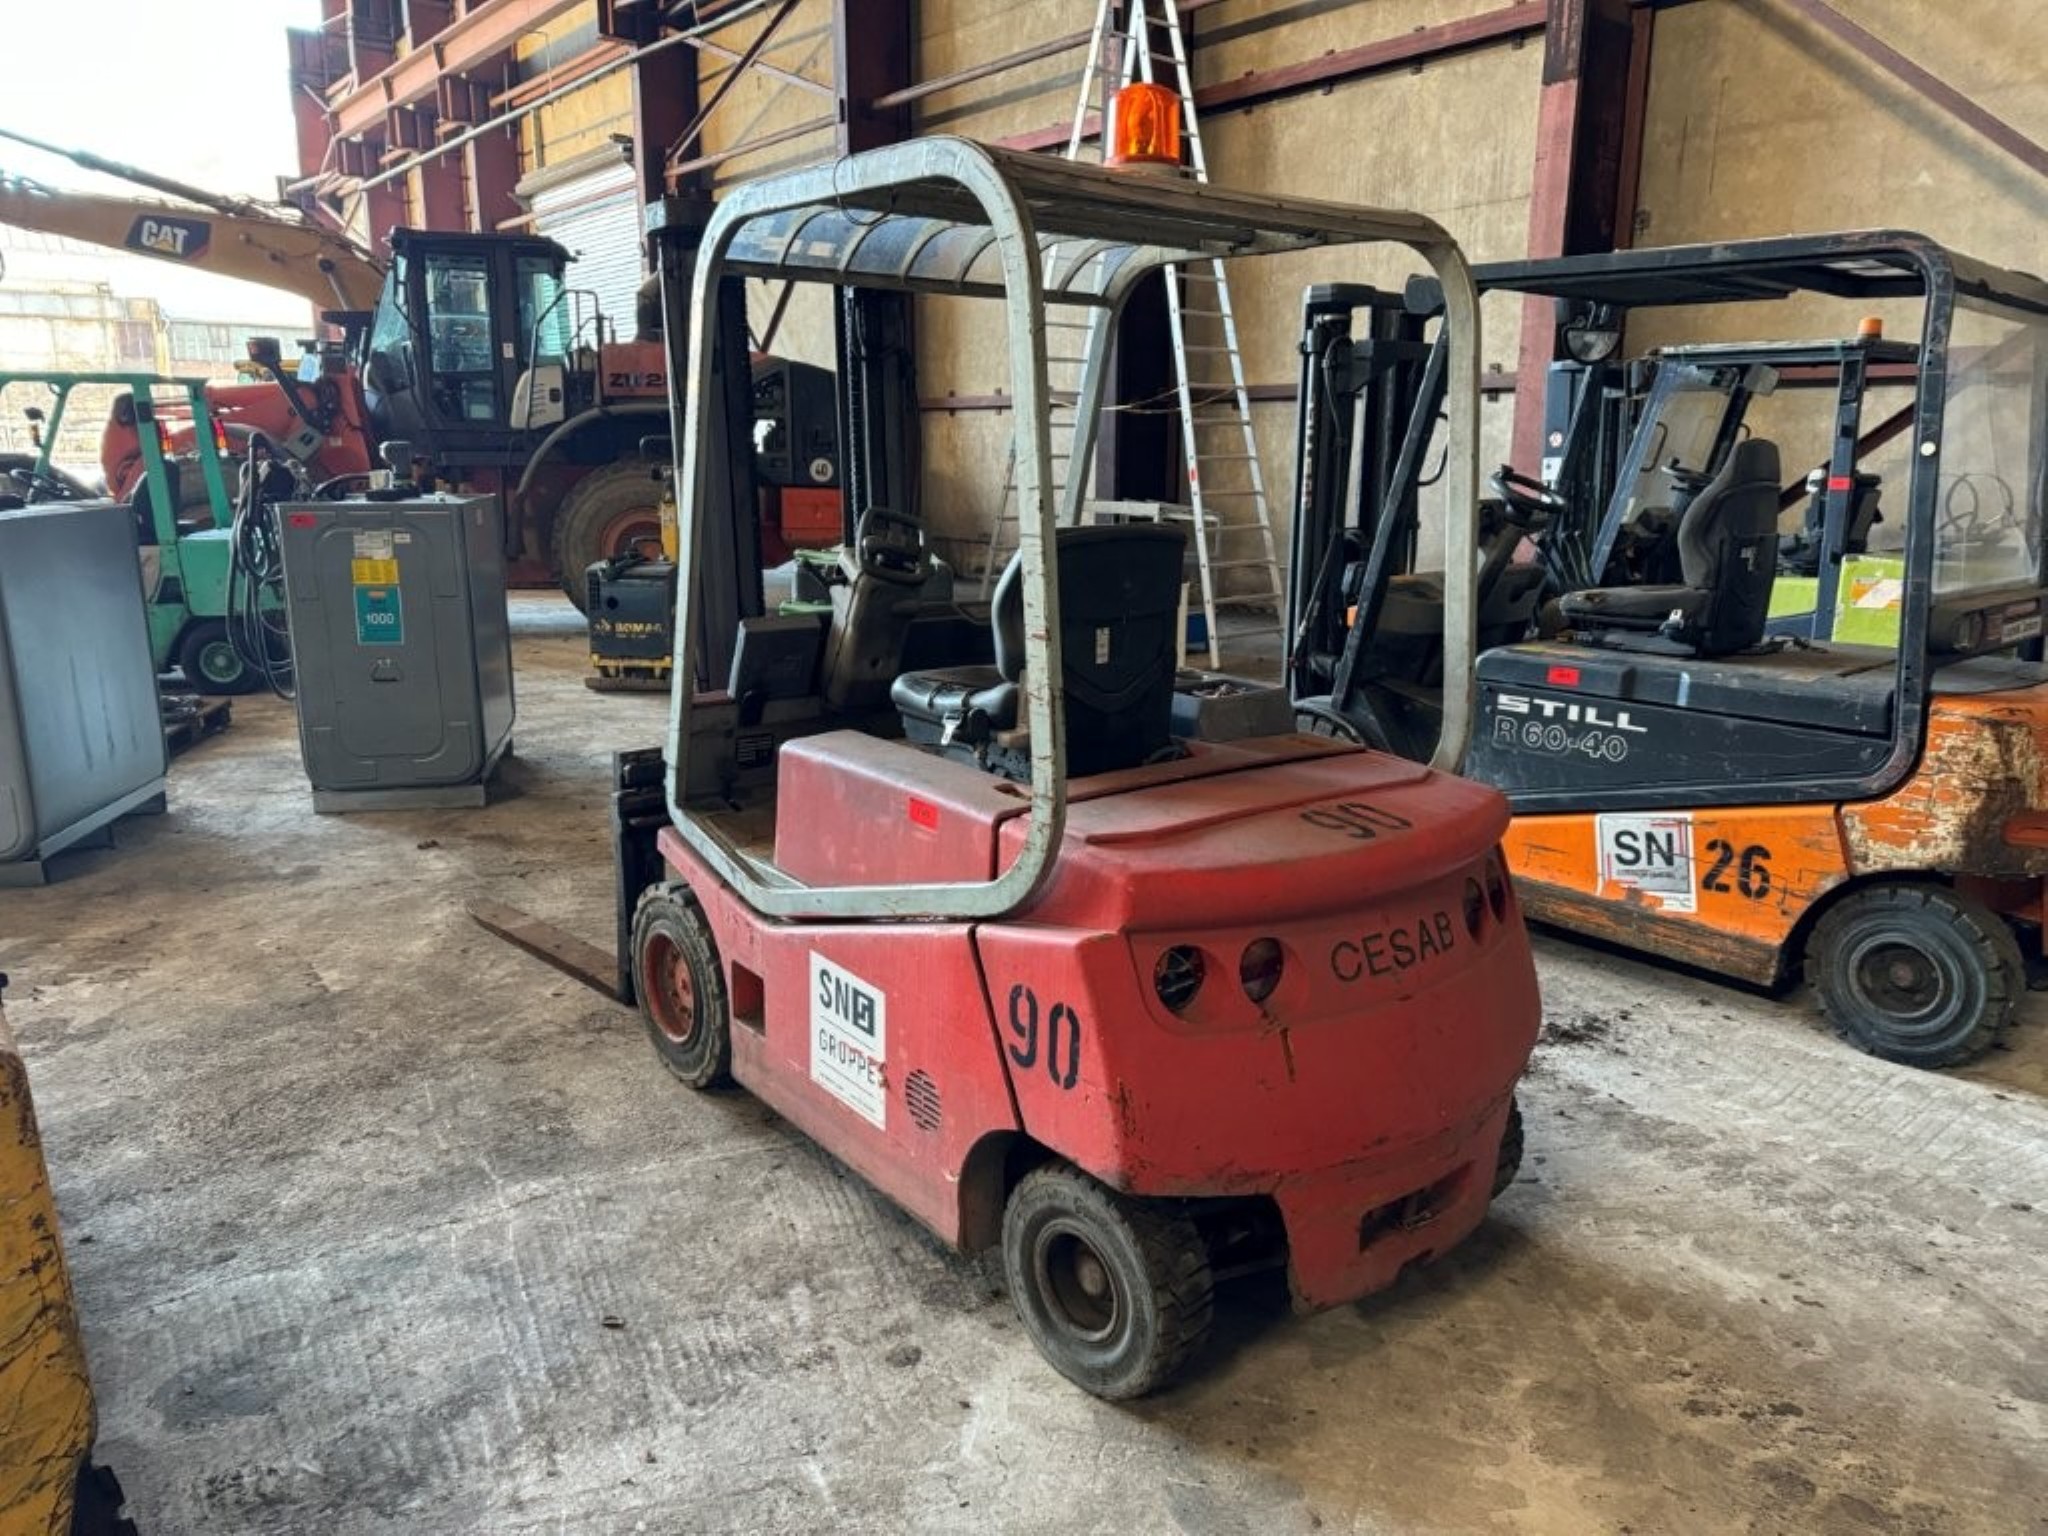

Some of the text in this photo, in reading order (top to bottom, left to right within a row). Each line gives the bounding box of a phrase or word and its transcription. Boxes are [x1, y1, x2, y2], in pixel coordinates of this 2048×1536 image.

[141, 220, 188, 255] CAT
[366, 612, 395, 625] 1000
[1497, 693, 1648, 733] STILL
[1493, 715, 1628, 763] R 60-40
[1301, 803, 1412, 838] 90
[1614, 830, 1675, 867] SN
[1702, 839, 1771, 900] 26
[1331, 911, 1454, 983] CESAB
[1008, 984, 1081, 1090] 90
